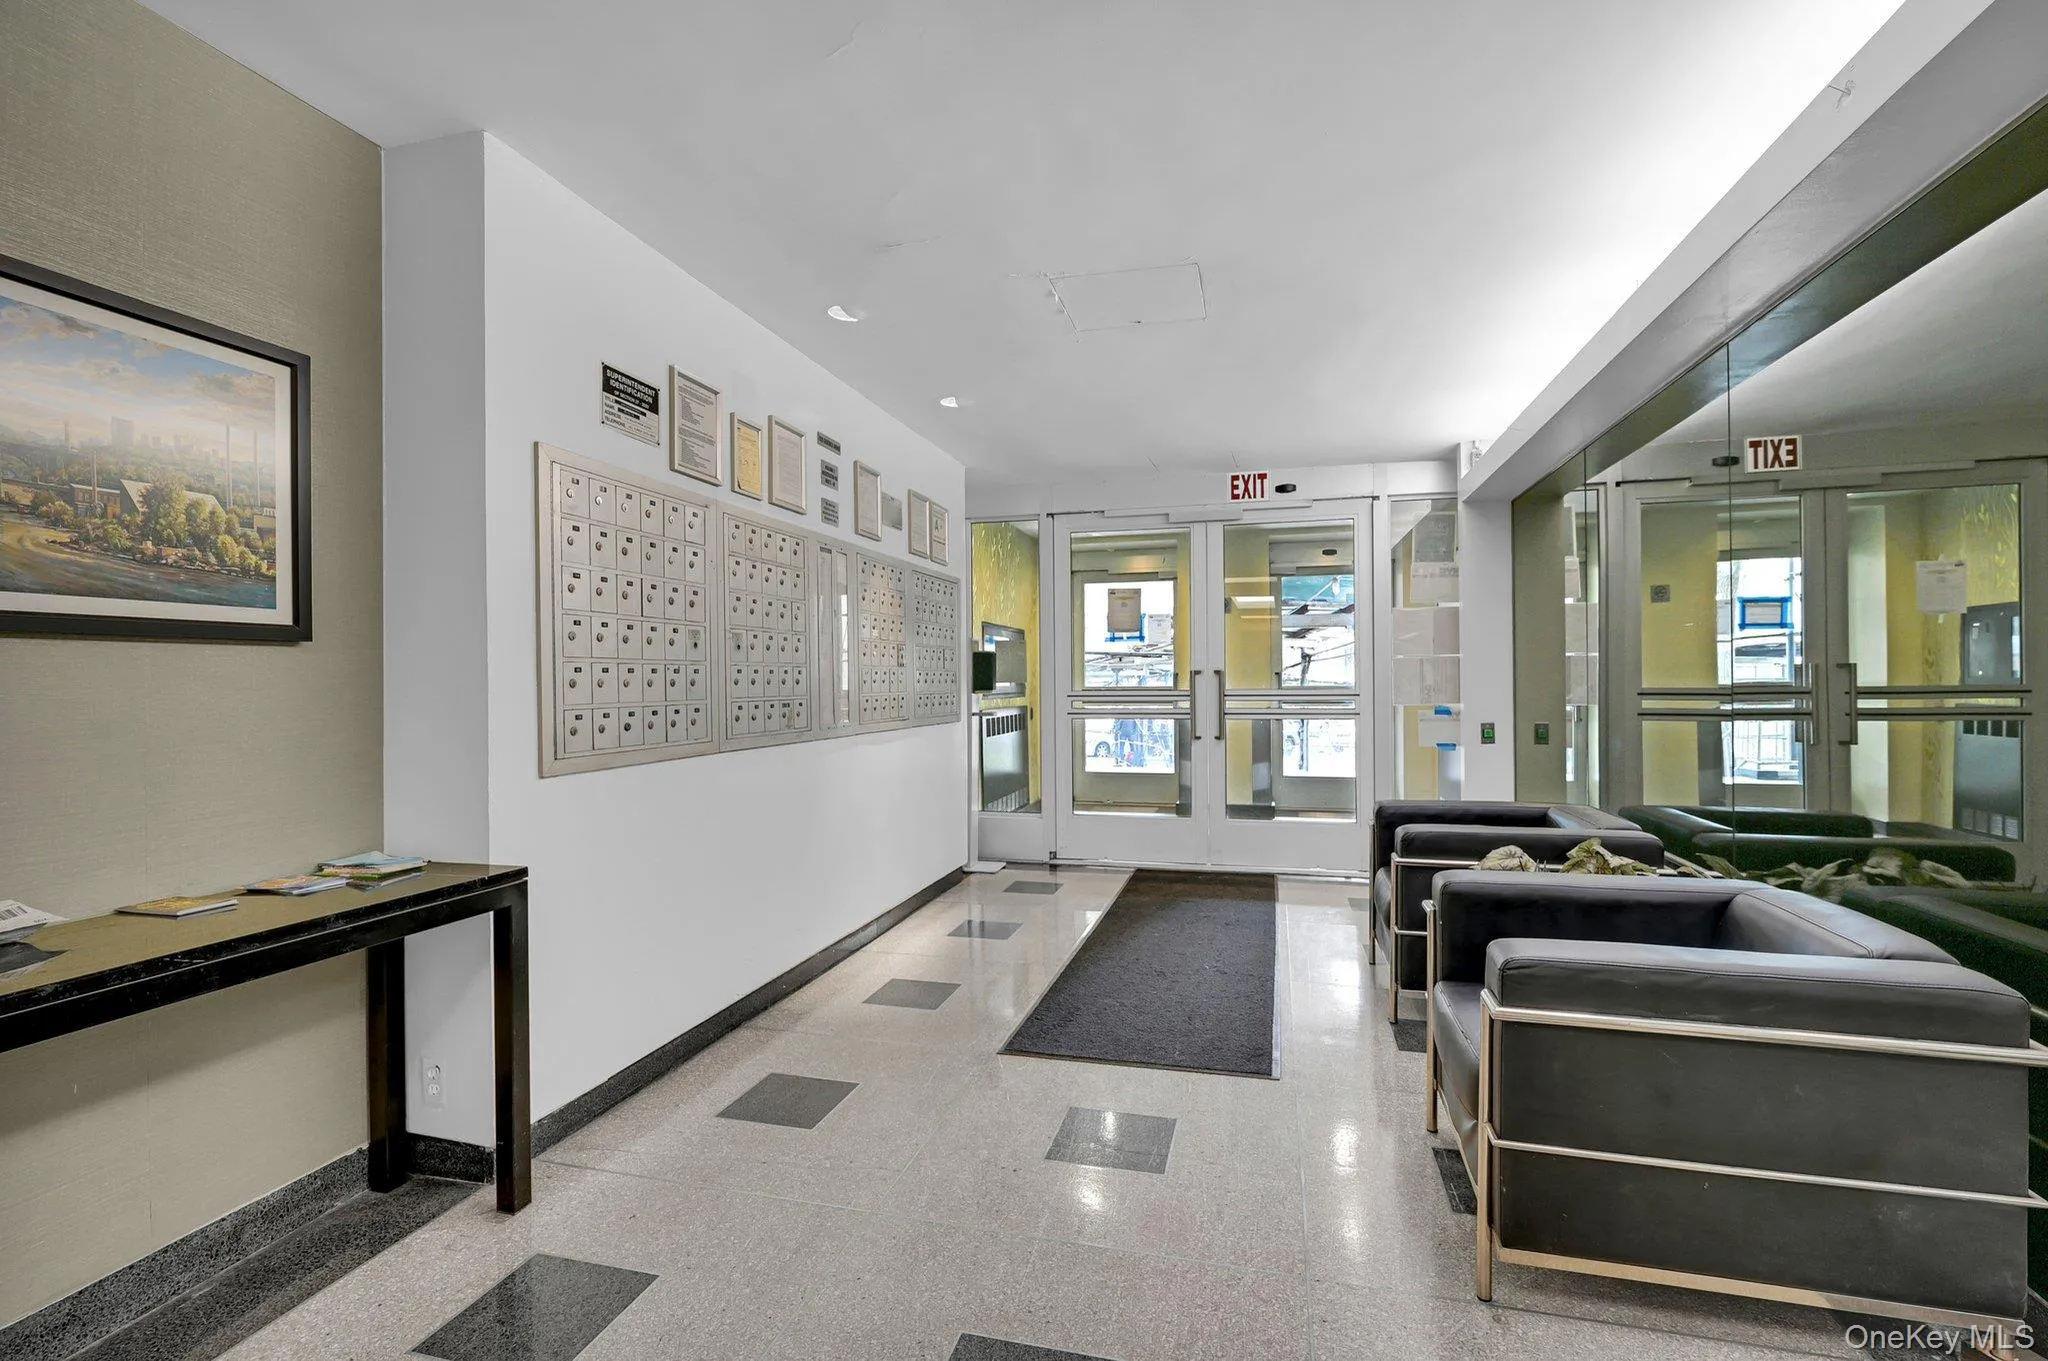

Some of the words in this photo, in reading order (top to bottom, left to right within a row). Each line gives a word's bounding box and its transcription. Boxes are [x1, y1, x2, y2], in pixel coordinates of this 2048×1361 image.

[606, 369, 656, 397] SUPERINTENDENT
[609, 379, 653, 404] IDENTIFICATION
[1231, 473, 1267, 500] EXIT
